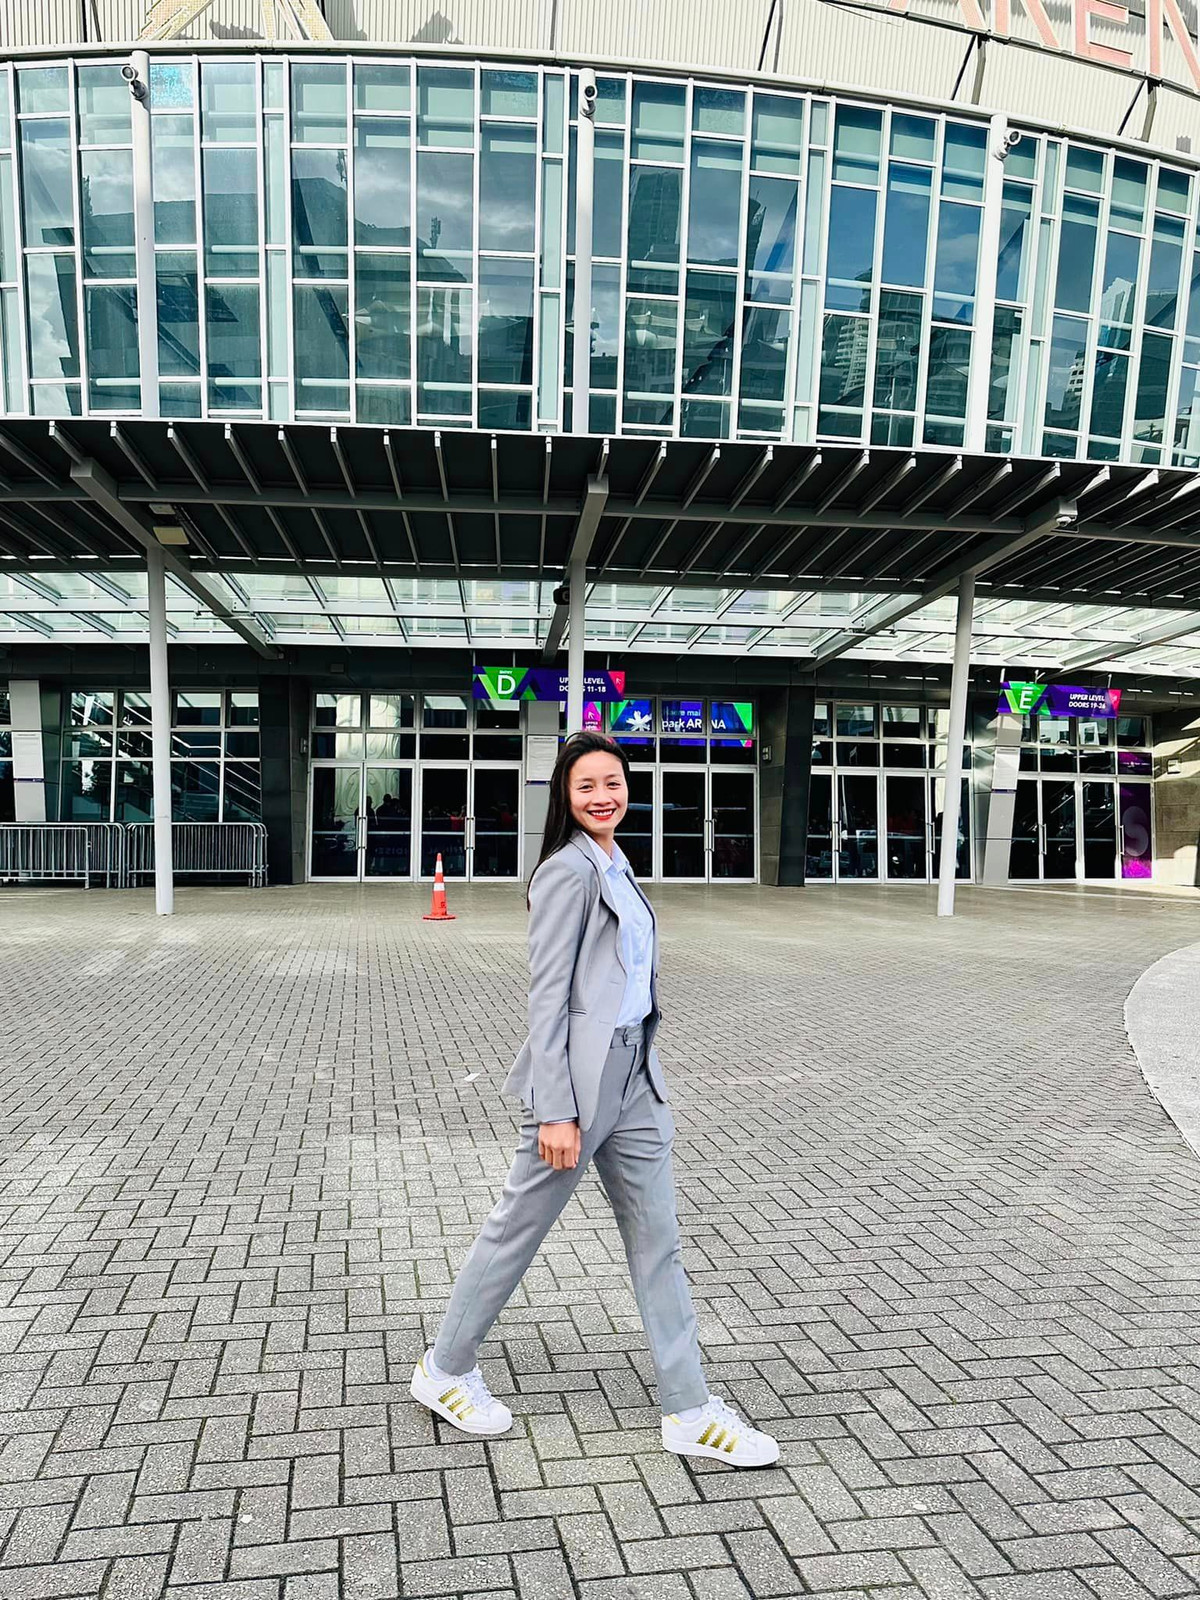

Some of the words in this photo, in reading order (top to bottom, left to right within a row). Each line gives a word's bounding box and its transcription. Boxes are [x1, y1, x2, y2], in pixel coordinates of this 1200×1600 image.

[497, 675, 516, 694] D
[1019, 689, 1033, 710] E
[1069, 693, 1089, 701] UPPER
[1089, 694, 1105, 702] LEVEL
[1068, 701, 1090, 709] DOORS
[686, 718, 727, 729] ARNA
